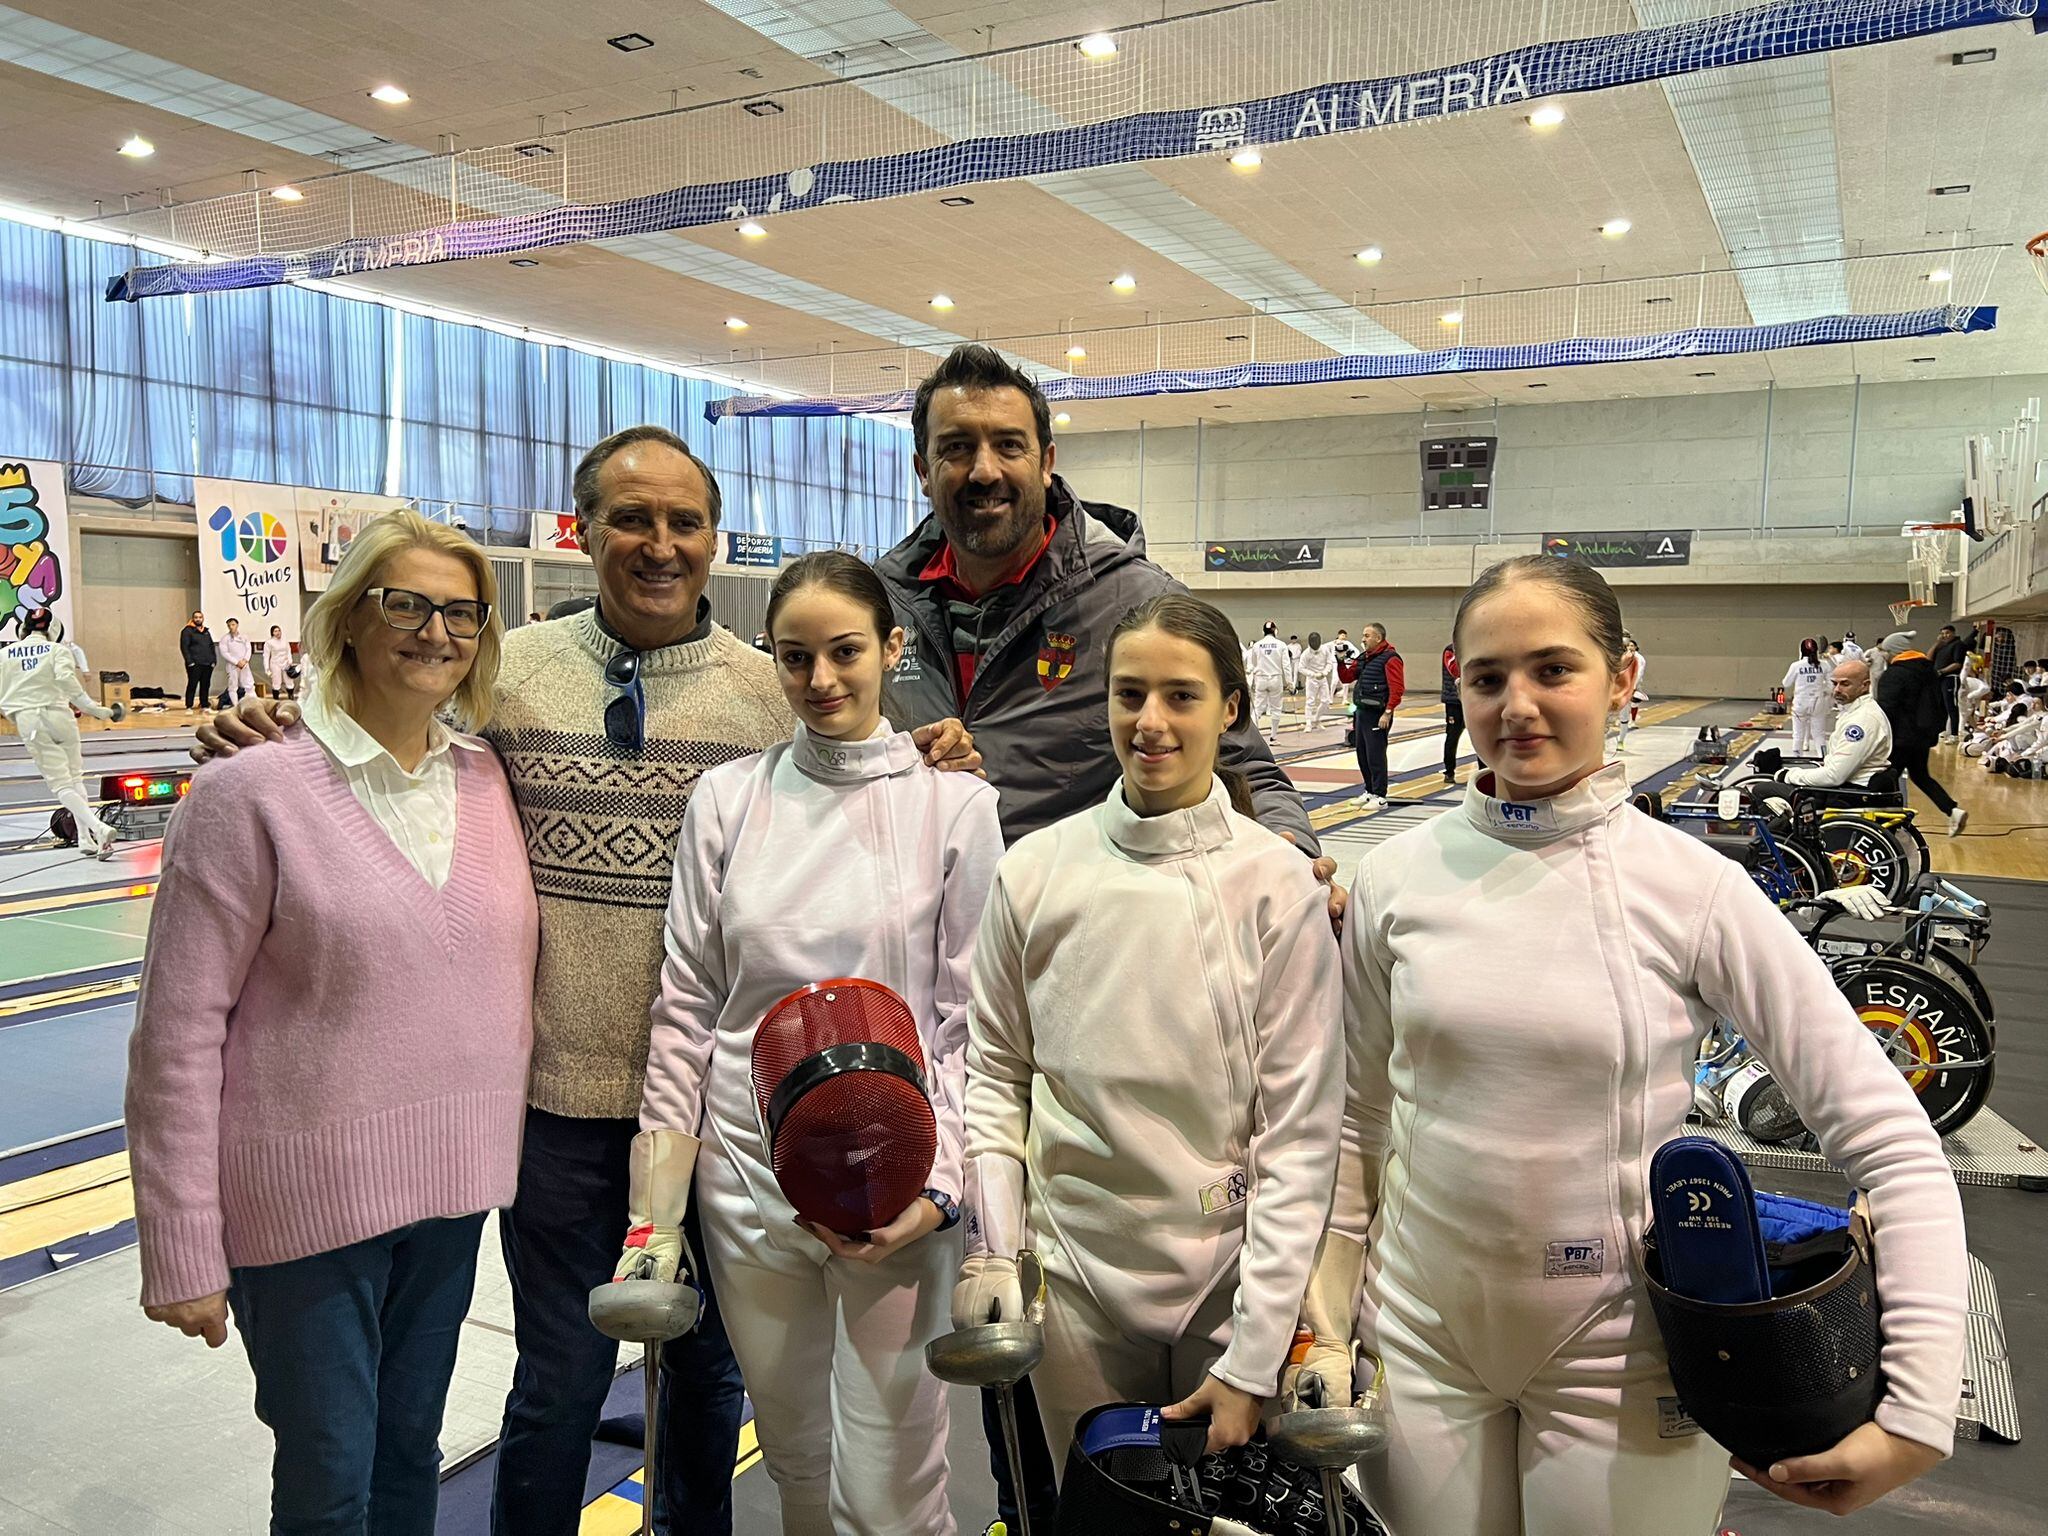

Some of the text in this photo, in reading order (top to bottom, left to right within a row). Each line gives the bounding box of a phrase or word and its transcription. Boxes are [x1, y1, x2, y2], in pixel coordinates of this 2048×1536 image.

[223, 564, 292, 590] Vamos
[238, 588, 278, 617] toyo
[8, 645, 51, 658] MATEOS
[22, 658, 38, 671] ESP
[1501, 803, 1537, 822] PBT
[1854, 835, 1890, 889] ESPA
[1866, 982, 1968, 1066] ESPAÑA
[1687, 1191, 1712, 1212] CE
[1564, 1246, 1593, 1261] PBT
